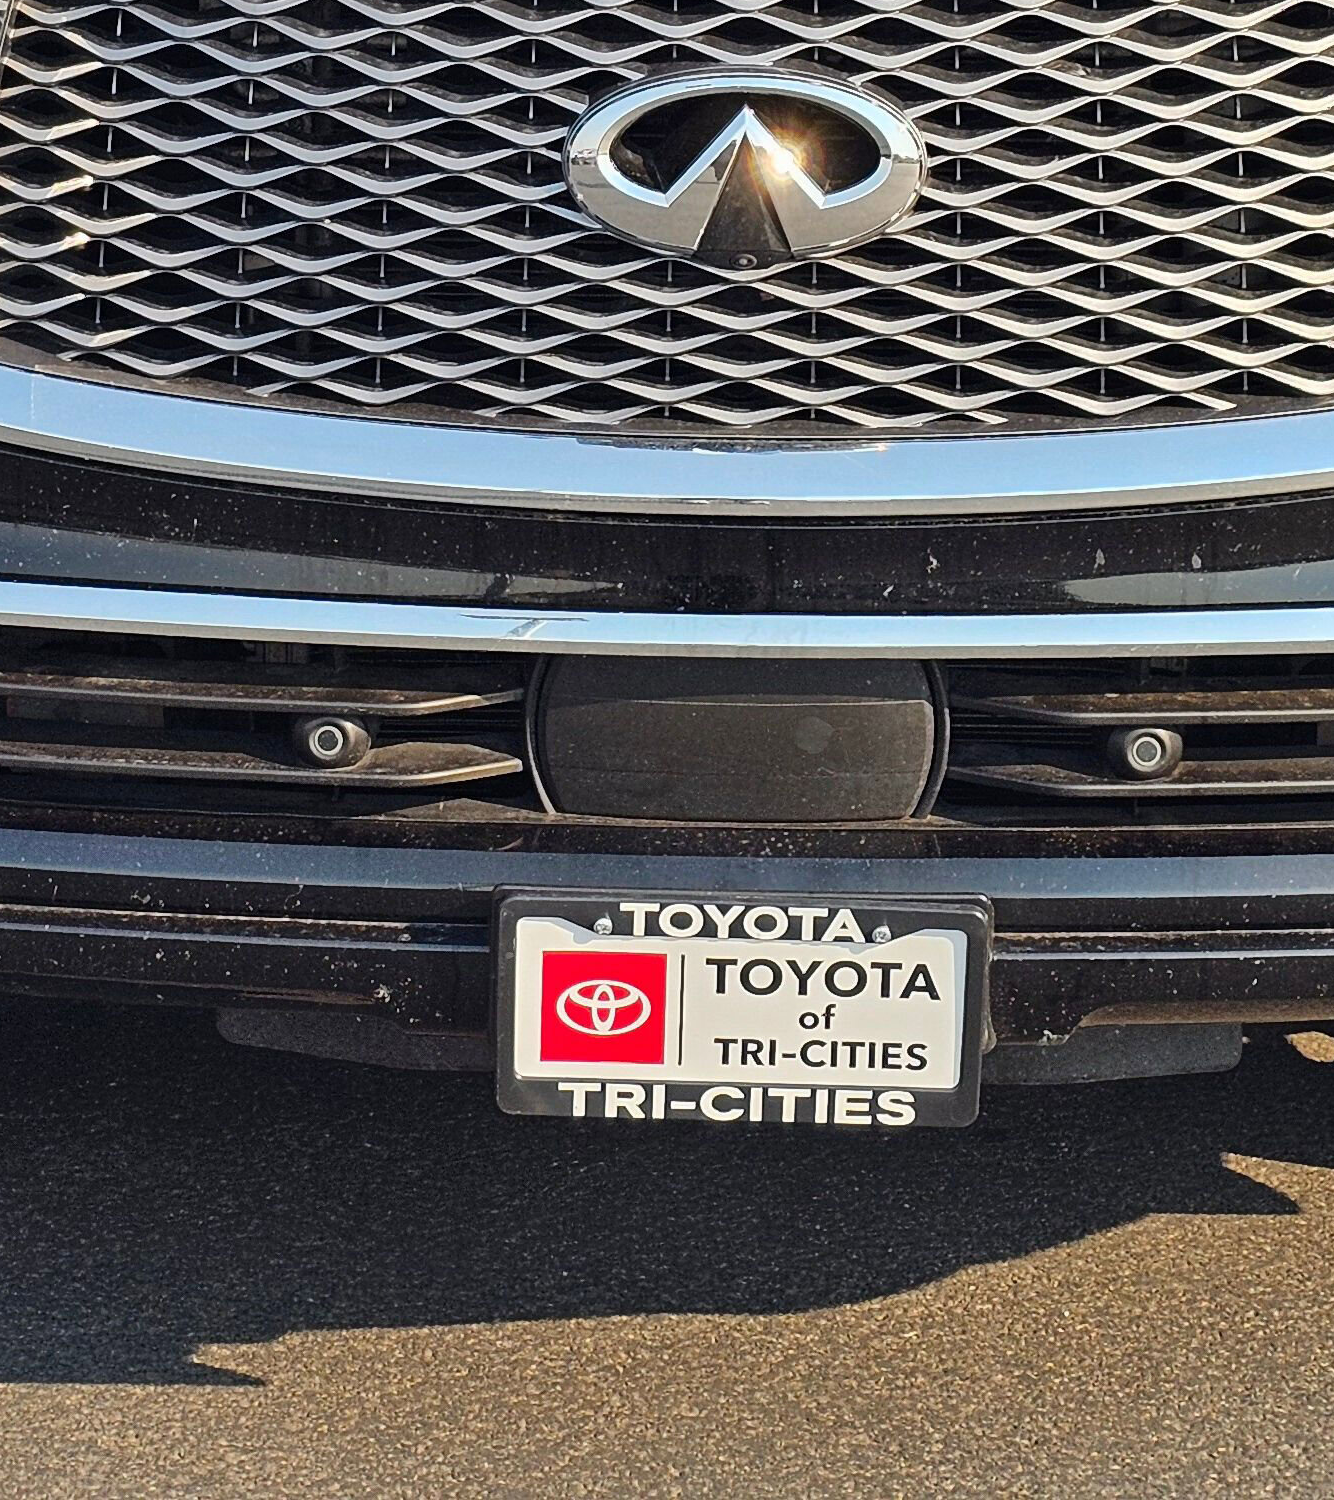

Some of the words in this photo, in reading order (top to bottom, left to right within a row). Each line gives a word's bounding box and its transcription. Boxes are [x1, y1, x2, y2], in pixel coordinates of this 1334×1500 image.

[619, 902, 866, 943] TOYOTA
[705, 957, 941, 1001] TOYOTA
[798, 1003, 837, 1030] of
[713, 1037, 928, 1071] TRI-CITIES
[557, 1081, 917, 1126] TRI-CITIES
